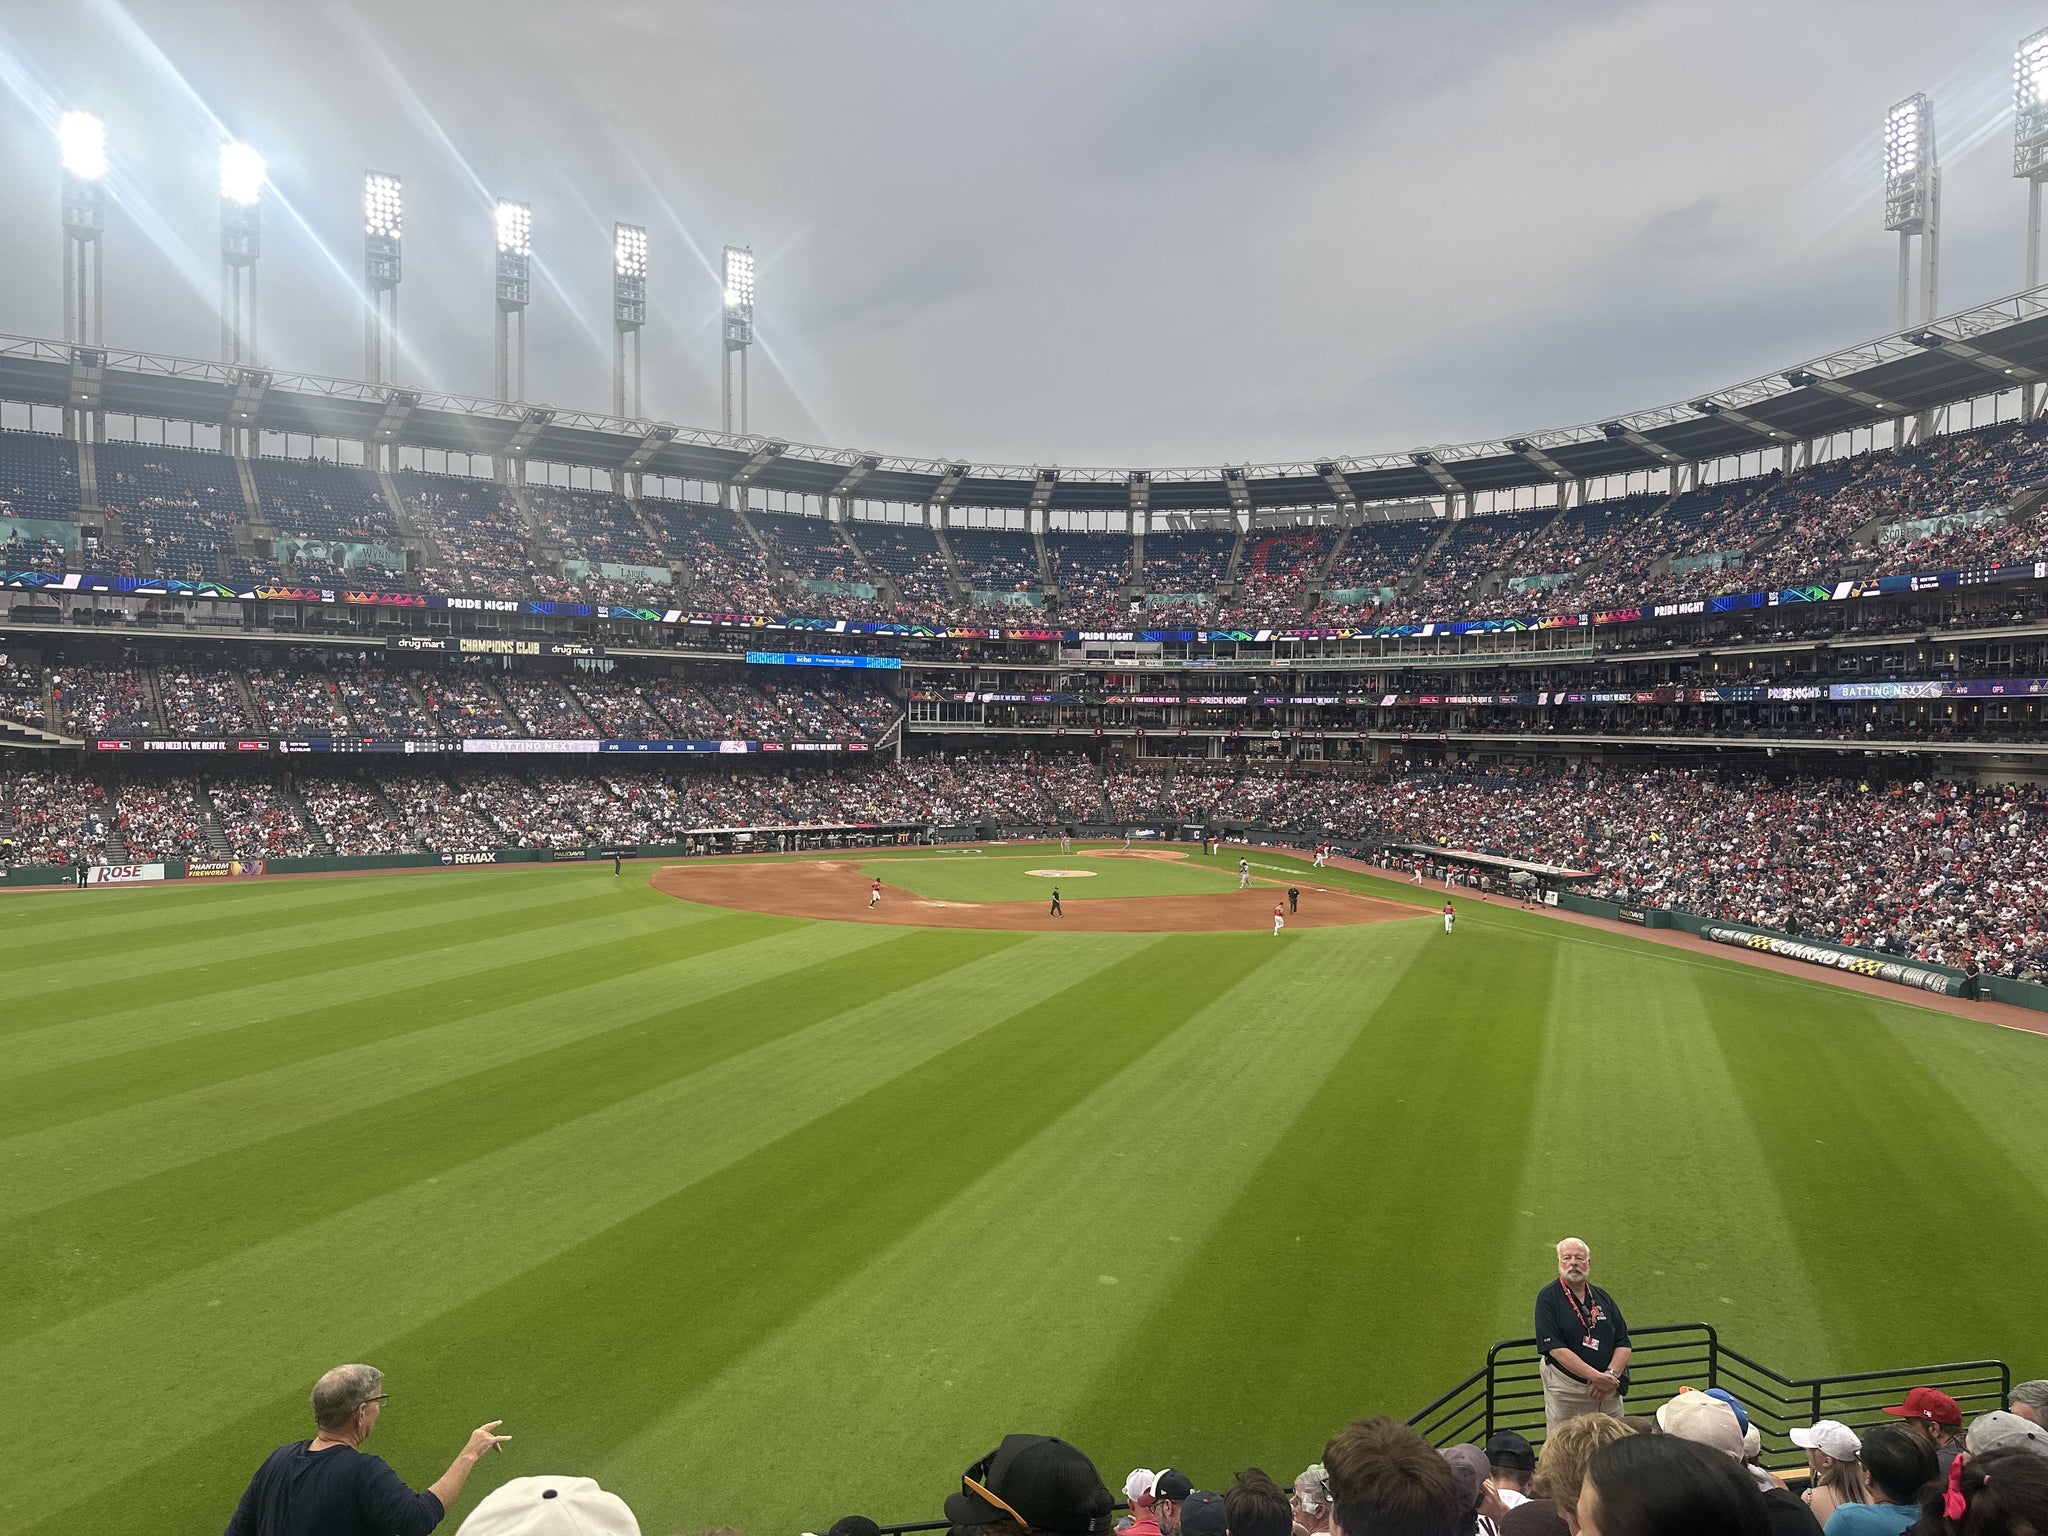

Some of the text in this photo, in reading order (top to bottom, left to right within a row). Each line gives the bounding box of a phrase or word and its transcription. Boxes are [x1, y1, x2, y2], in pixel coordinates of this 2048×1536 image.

[362, 548, 390, 560] WYNN
[447, 598, 518, 612] PRIDE NIGHT
[1654, 601, 1705, 617] PRIDE NIGHT
[1079, 632, 1134, 641] PRIDE NIGHT
[398, 639, 421, 650] drug
[422, 641, 445, 649] mart
[460, 639, 540, 655] CHAMPIONS CLUB
[551, 645, 571, 655] drug
[573, 647, 594, 655] mart
[1842, 685, 1923, 696] BATTING NEXT
[1956, 686, 1968, 694] AVG
[1992, 685, 2004, 693] OPS
[1200, 696, 1223, 704] PRIDE
[1224, 696, 1247, 704] NIGHT
[144, 741, 150, 750] IF
[151, 741, 164, 750] YOU
[165, 741, 182, 750] NEED
[182, 741, 190, 750] IT,
[191, 741, 201, 750] WE
[202, 741, 218, 750] RENT
[440, 743, 445, 751] 0
[448, 743, 453, 751] 0
[456, 743, 461, 751] 0
[1194, 830, 1200, 840] C
[189, 863, 229, 871] PHANTOM
[97, 865, 142, 882] ROSE
[188, 869, 229, 877] FIREWORKS
[1770, 940, 1853, 968] CONRAD'S
